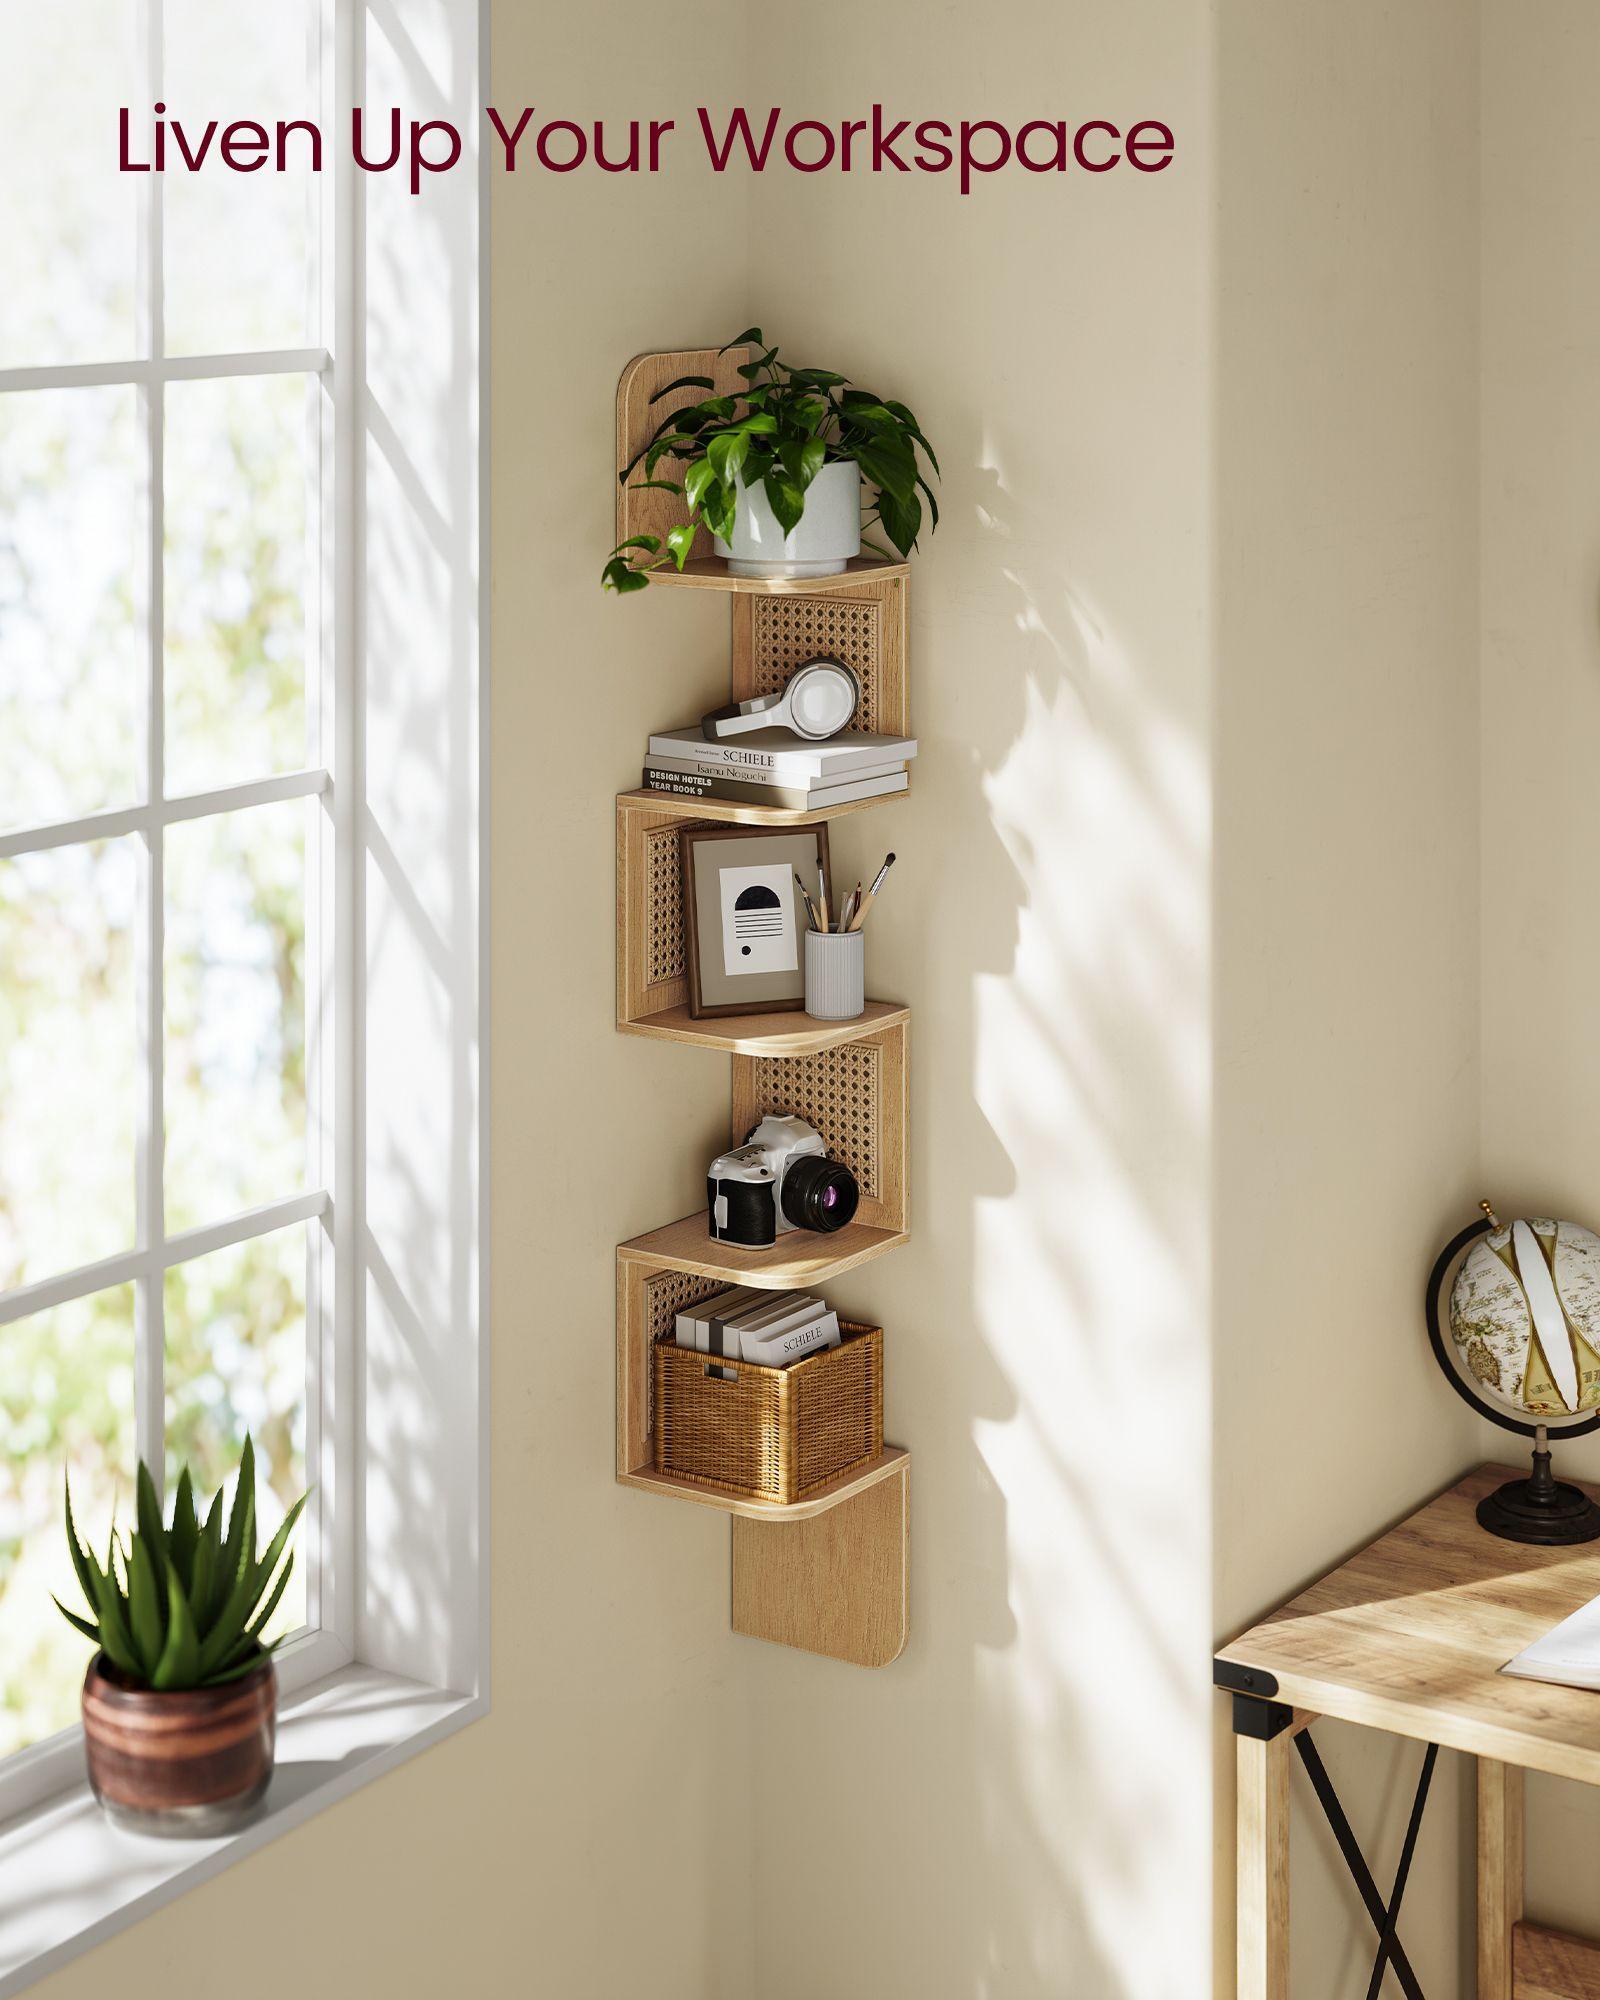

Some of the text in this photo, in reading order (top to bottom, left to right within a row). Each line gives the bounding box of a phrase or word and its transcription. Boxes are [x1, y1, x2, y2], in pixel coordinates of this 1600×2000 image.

[723, 749, 775, 767] SCHIELE
[650, 770, 712, 787] DESIGN HOTELS
[697, 763, 767, 782] Isamu Noguchi
[650, 780, 703, 796] YEAR BOOK 9
[783, 1326, 823, 1353] SCHIELE
